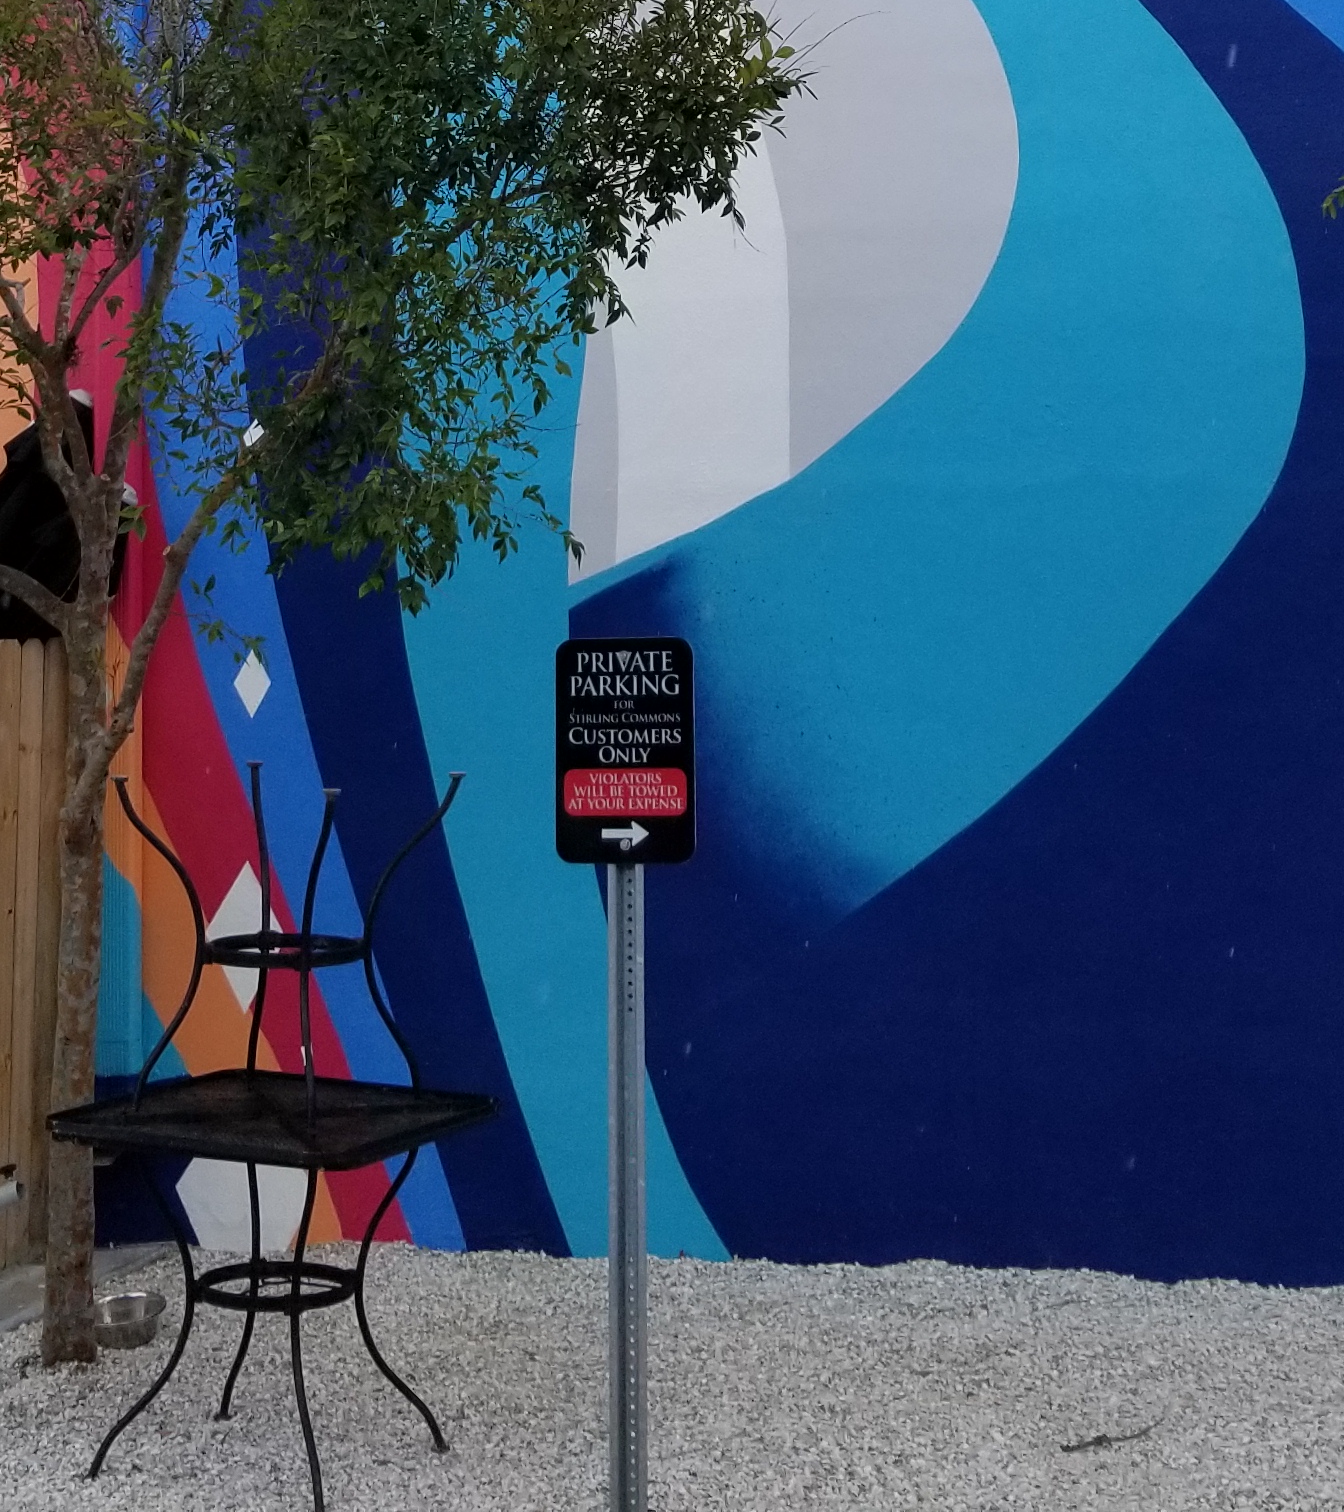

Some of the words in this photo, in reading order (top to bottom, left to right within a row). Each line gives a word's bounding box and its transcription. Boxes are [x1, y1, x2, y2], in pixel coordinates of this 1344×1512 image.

[576, 650, 673, 673] PRIVATE
[570, 674, 680, 696] PARKING
[613, 700, 634, 709] FOR
[569, 713, 619, 724] STIRLING
[621, 712, 681, 723] COMMONS
[568, 727, 682, 744] CUSTOMERS
[598, 745, 651, 763] ONLY
[589, 773, 662, 784] VIOLATORS
[573, 786, 606, 797] WILL
[610, 785, 625, 797] BE
[628, 785, 678, 797] TOWED
[568, 798, 585, 809] AT
[587, 798, 625, 810] YOUR
[628, 797, 684, 810] EXPENSE
